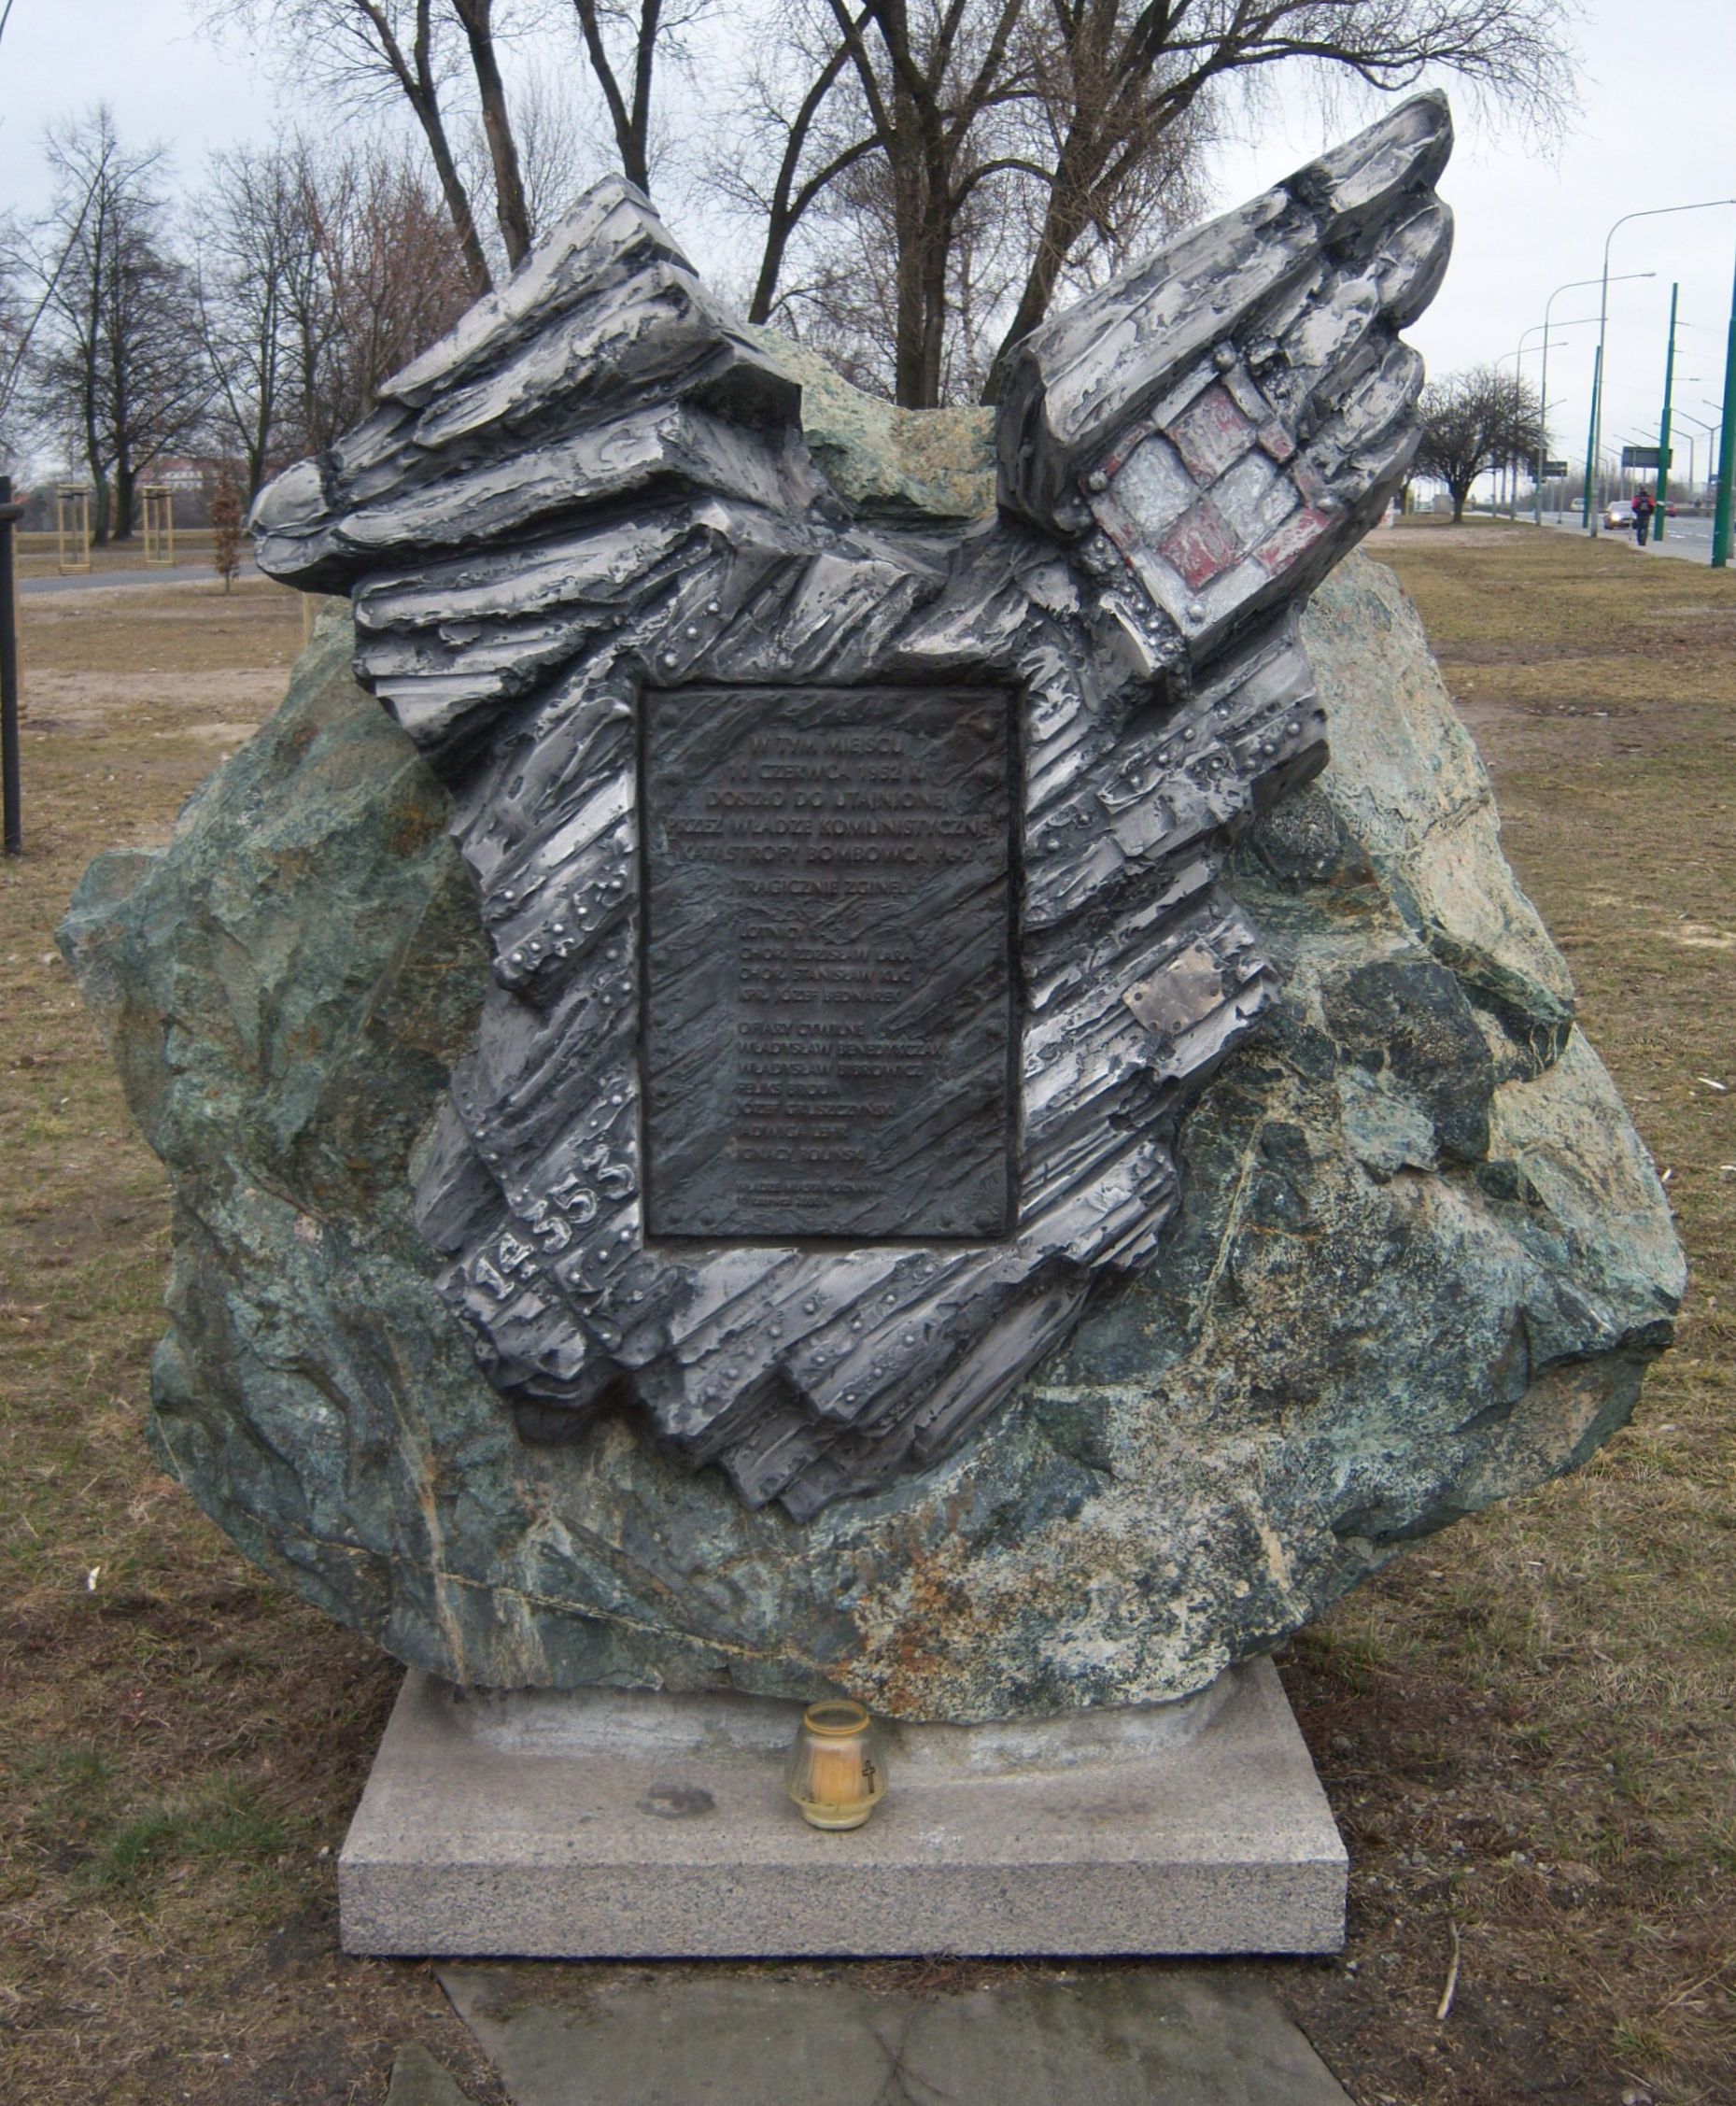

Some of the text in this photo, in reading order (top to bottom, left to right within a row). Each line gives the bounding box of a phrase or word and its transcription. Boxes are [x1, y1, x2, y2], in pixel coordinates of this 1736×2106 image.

[751, 736, 904, 756] W TYM MIEJSCU
[730, 763, 750, 781] 10
[759, 764, 851, 782] CZERWCA
[857, 764, 901, 782] 1952
[706, 790, 783, 808] DOSZŁO
[794, 790, 824, 808] DO
[667, 817, 724, 835] PRZEZ
[732, 817, 812, 836] WŁADZE
[681, 844, 799, 862] KATASTROFY
[808, 844, 927, 863] BOMBOWCA
[734, 879, 839, 896] TRAGICZNIE
[792, 968, 873, 982] STANISŁAW
[738, 1023, 792, 1037] OFIARY
[738, 1040, 832, 1055] WŁADYSŁAW
[738, 1061, 833, 1076] WŁADYSŁAW
